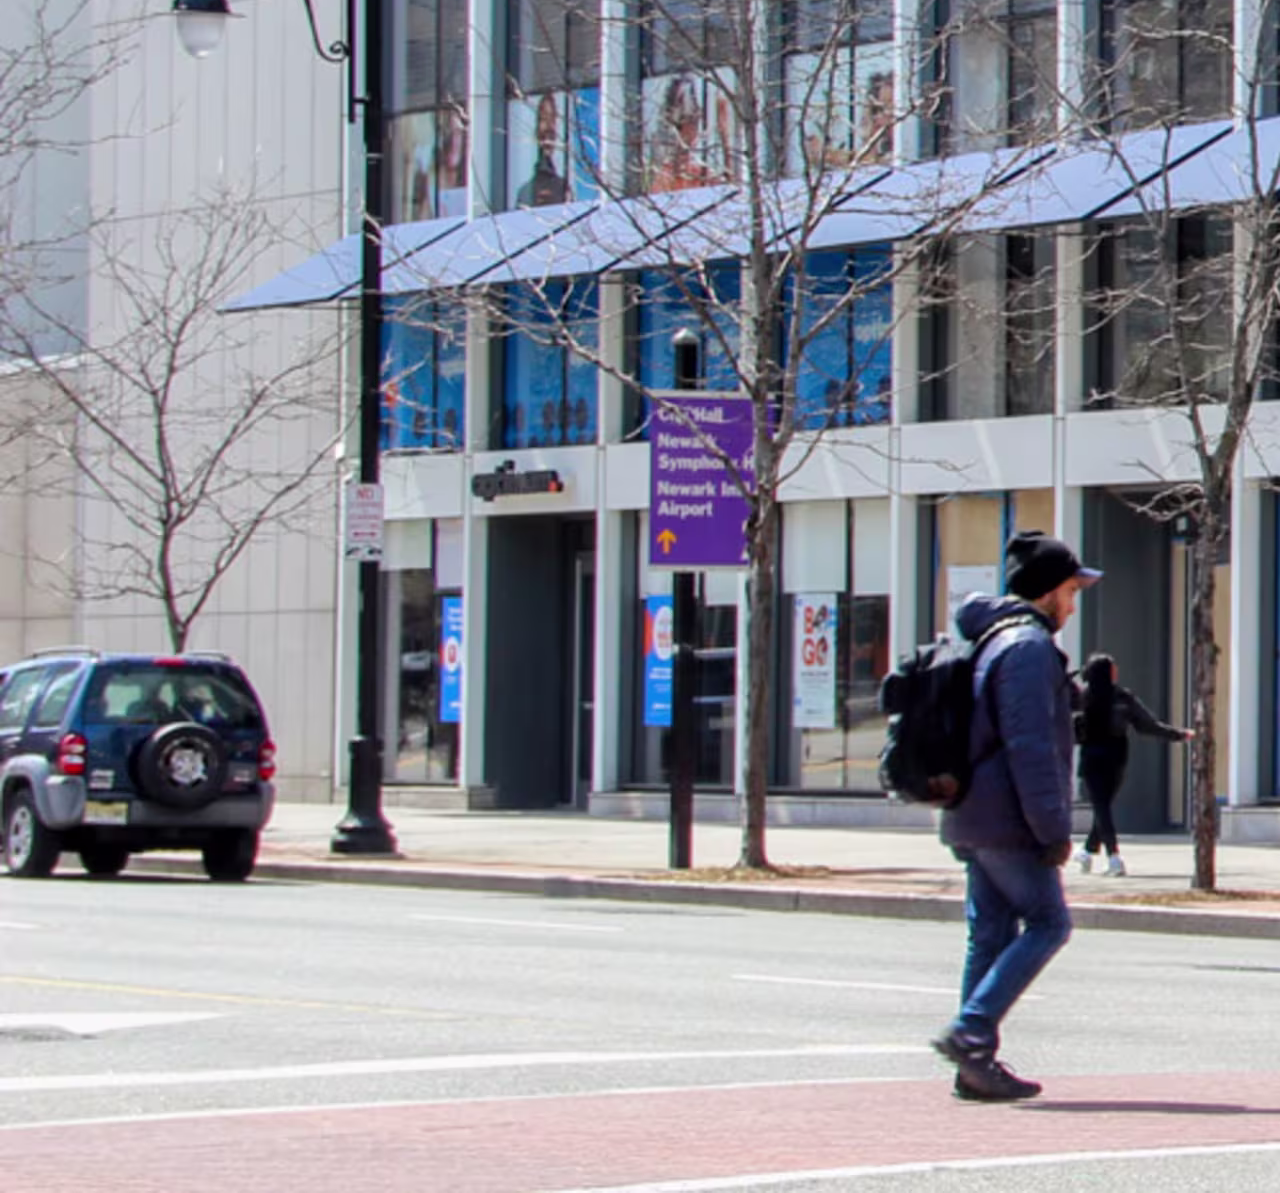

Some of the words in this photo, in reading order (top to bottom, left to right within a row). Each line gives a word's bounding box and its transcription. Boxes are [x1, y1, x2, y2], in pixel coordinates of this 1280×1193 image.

[657, 453, 739, 472] Sympho
[657, 480, 716, 496] Newark
[657, 500, 713, 520] Airport
